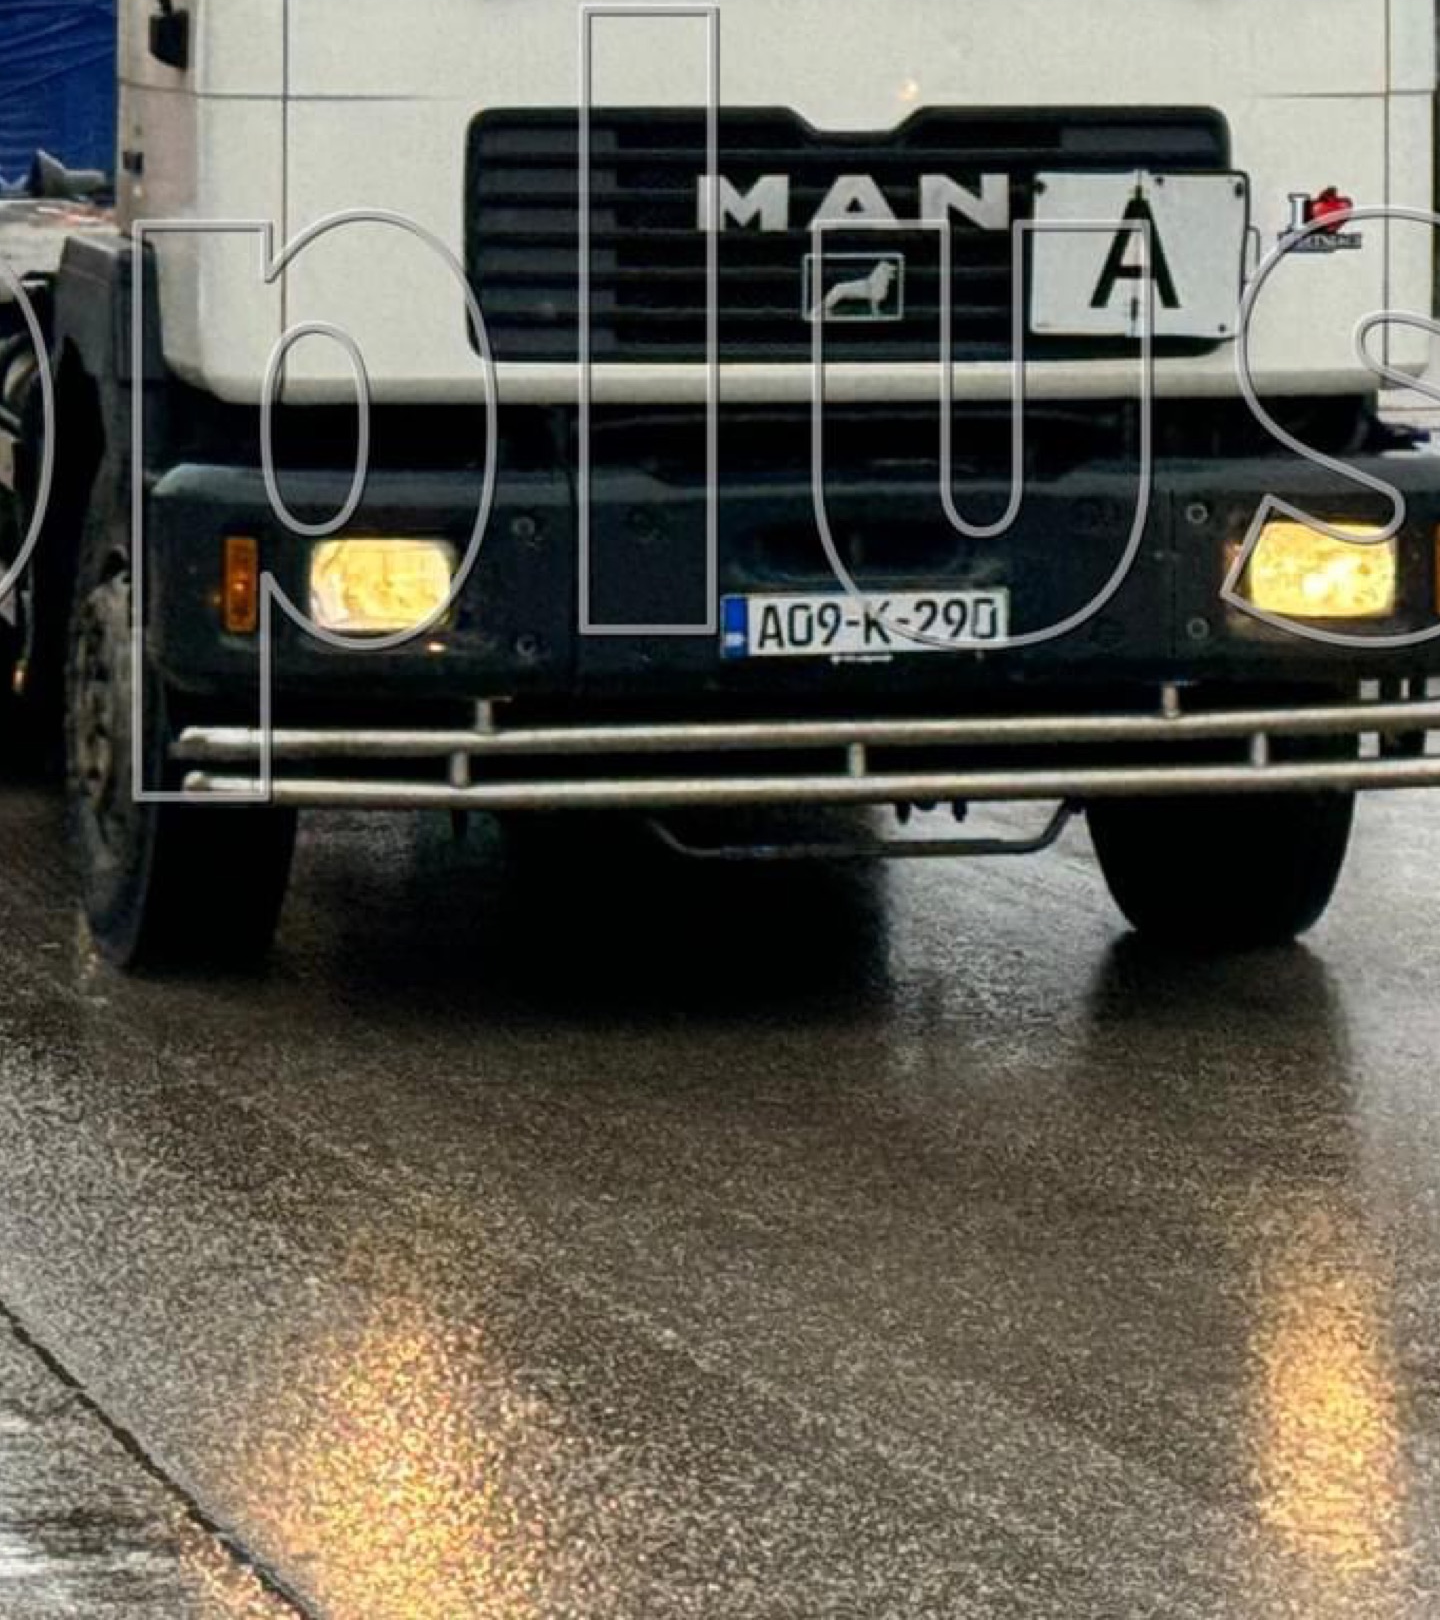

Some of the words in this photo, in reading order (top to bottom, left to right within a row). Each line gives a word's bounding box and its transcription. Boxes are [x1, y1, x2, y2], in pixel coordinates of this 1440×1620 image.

[696, 173, 1010, 232] MAN
[1088, 186, 1183, 309] A
[757, 597, 1000, 651] A09-K-290
